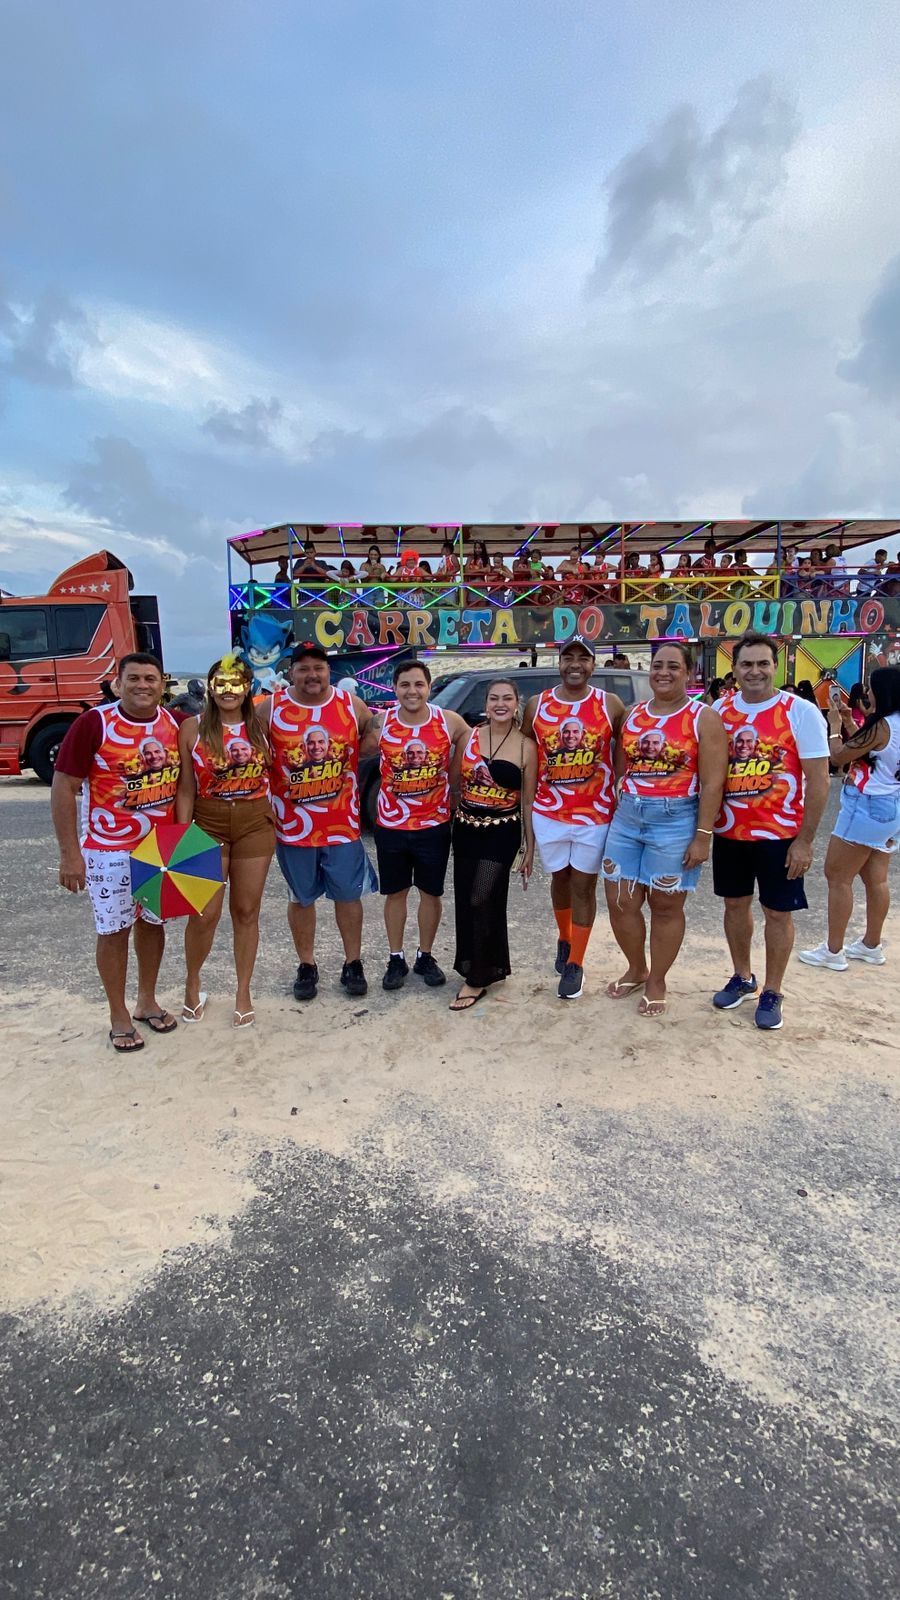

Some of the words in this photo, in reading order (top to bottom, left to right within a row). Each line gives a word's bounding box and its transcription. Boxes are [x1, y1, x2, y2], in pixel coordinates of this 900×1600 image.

[315, 608, 518, 648] CARRETA
[552, 605, 604, 641] DO
[547, 757, 557, 766] OS
[556, 749, 594, 767] LEÃO
[728, 758, 770, 778] LEÃO
[127, 779, 143, 792] OS
[142, 767, 180, 789] LEÃO
[290, 771, 304, 784] OS
[303, 760, 343, 783] LEÃO
[394, 773, 403, 781] OS
[402, 766, 438, 782] LEÃO
[289, 777, 343, 801] ZINHOS
